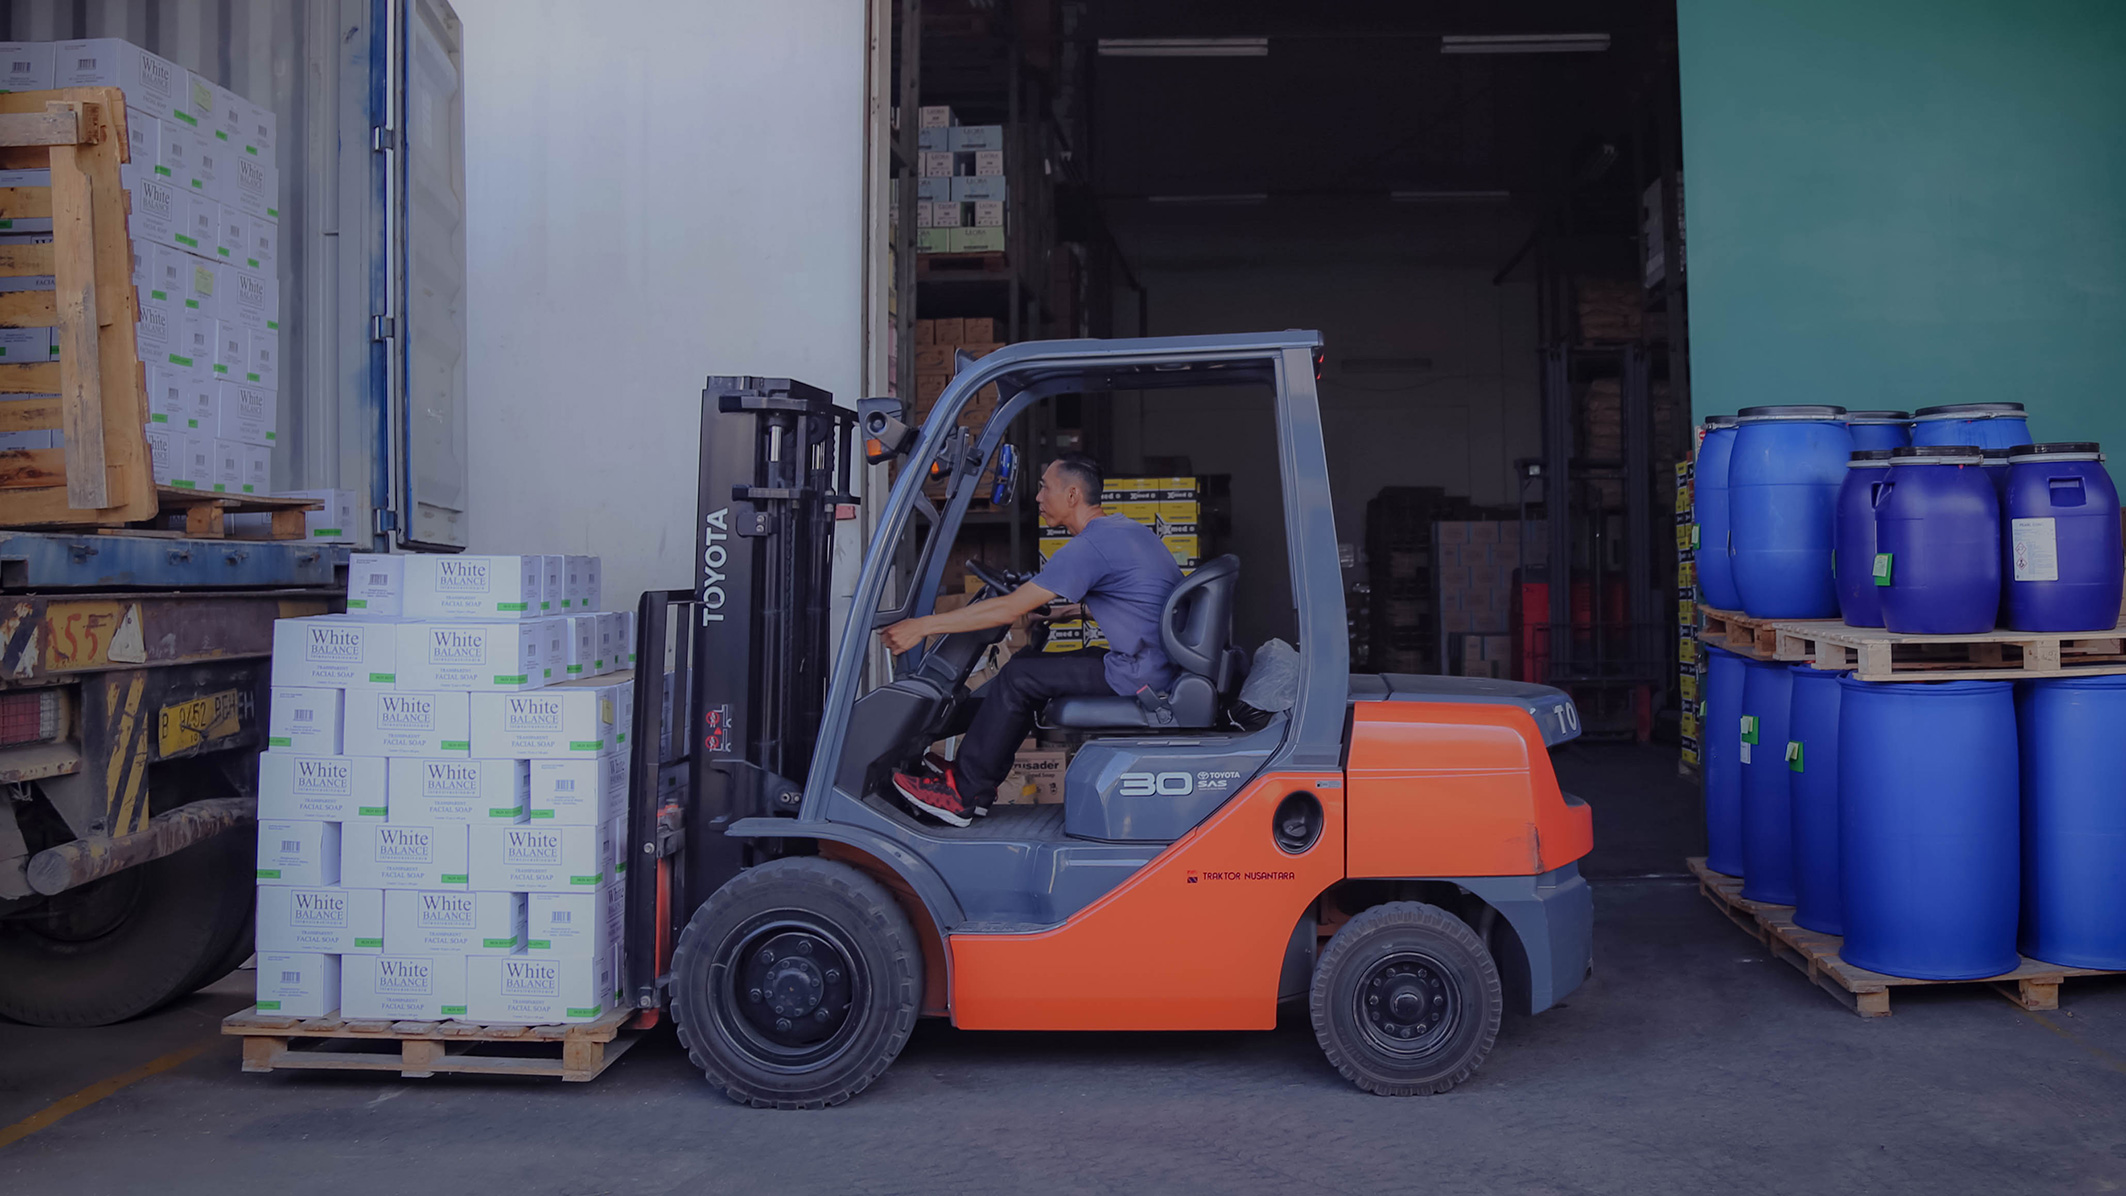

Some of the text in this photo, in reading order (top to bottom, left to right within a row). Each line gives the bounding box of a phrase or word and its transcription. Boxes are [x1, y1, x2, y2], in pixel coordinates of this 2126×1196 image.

[142, 56, 169, 81] White
[240, 160, 264, 182] White
[143, 182, 170, 205] White
[240, 277, 264, 296] White
[138, 306, 166, 327] White
[240, 389, 263, 408] White
[149, 434, 168, 451] hite
[440, 561, 486, 576] White
[703, 508, 729, 626] TOYOTA
[440, 577, 486, 585] BALANCE
[311, 629, 359, 645] White
[434, 631, 482, 647] White
[311, 645, 359, 655] BALANCE
[434, 648, 482, 657] BALANCE
[383, 697, 430, 713] White
[510, 699, 558, 714] White
[382, 713, 430, 723] BALANCE
[510, 715, 558, 724] BALANCE
[299, 762, 347, 778] White
[428, 764, 476, 780] White
[1014, 761, 1060, 770] rusader
[1210, 771, 1241, 779] TOYOTA
[298, 778, 347, 788] BALANCE
[428, 780, 476, 790] BALANCE
[1119, 771, 1194, 796] 30
[1198, 780, 1228, 788] SAS
[299, 803, 324, 811] FACIAL
[380, 829, 428, 845] White
[509, 832, 557, 847] White
[380, 846, 428, 855] BALANCE
[509, 848, 557, 857] BALANCE
[1203, 872, 1295, 880] TRAKTOR NUSANTARA
[295, 894, 343, 910] White
[423, 895, 472, 911] White
[295, 910, 343, 920] BALANCE
[423, 911, 472, 921] BALANCE
[380, 961, 428, 977] White
[506, 962, 555, 979] White
[380, 977, 428, 987] BALANCE
[506, 979, 555, 989] BALANCE
